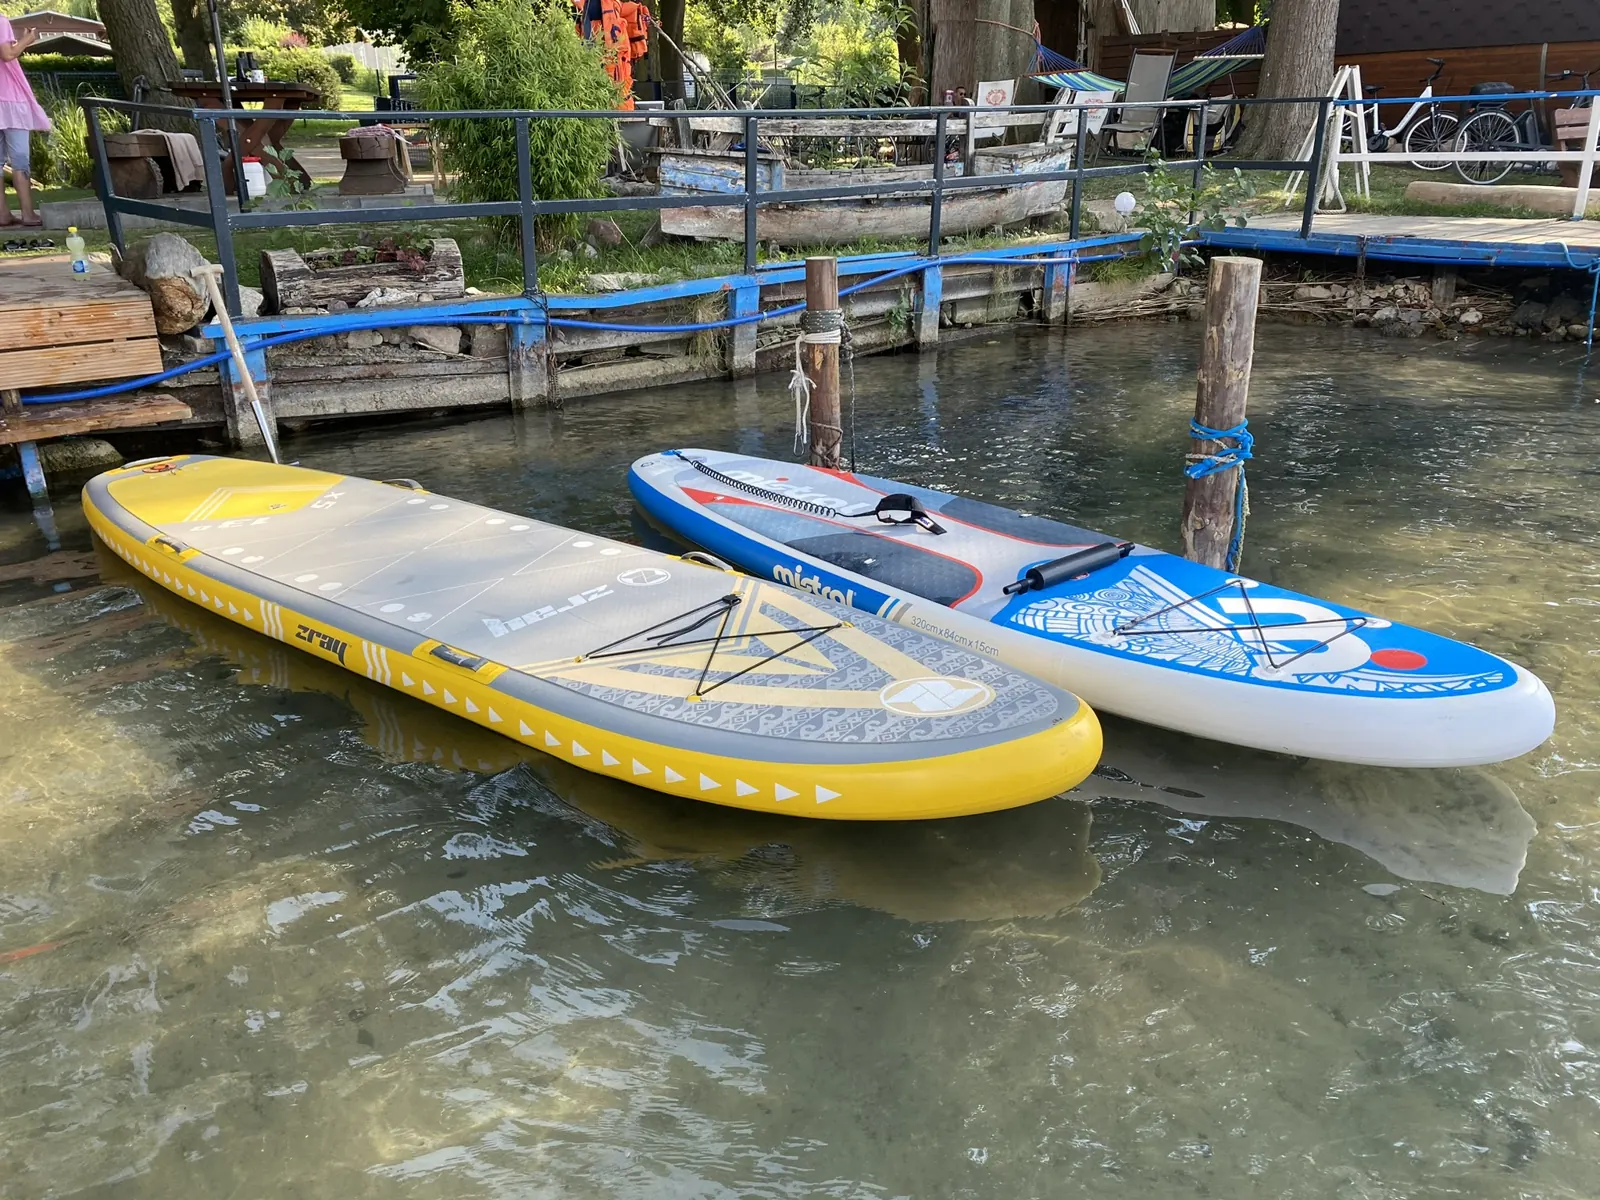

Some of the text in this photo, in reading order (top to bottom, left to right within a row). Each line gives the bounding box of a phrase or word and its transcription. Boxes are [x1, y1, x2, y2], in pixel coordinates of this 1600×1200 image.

[773, 564, 853, 608] mistral
[481, 584, 614, 638] zray
[295, 624, 347, 667] zray
